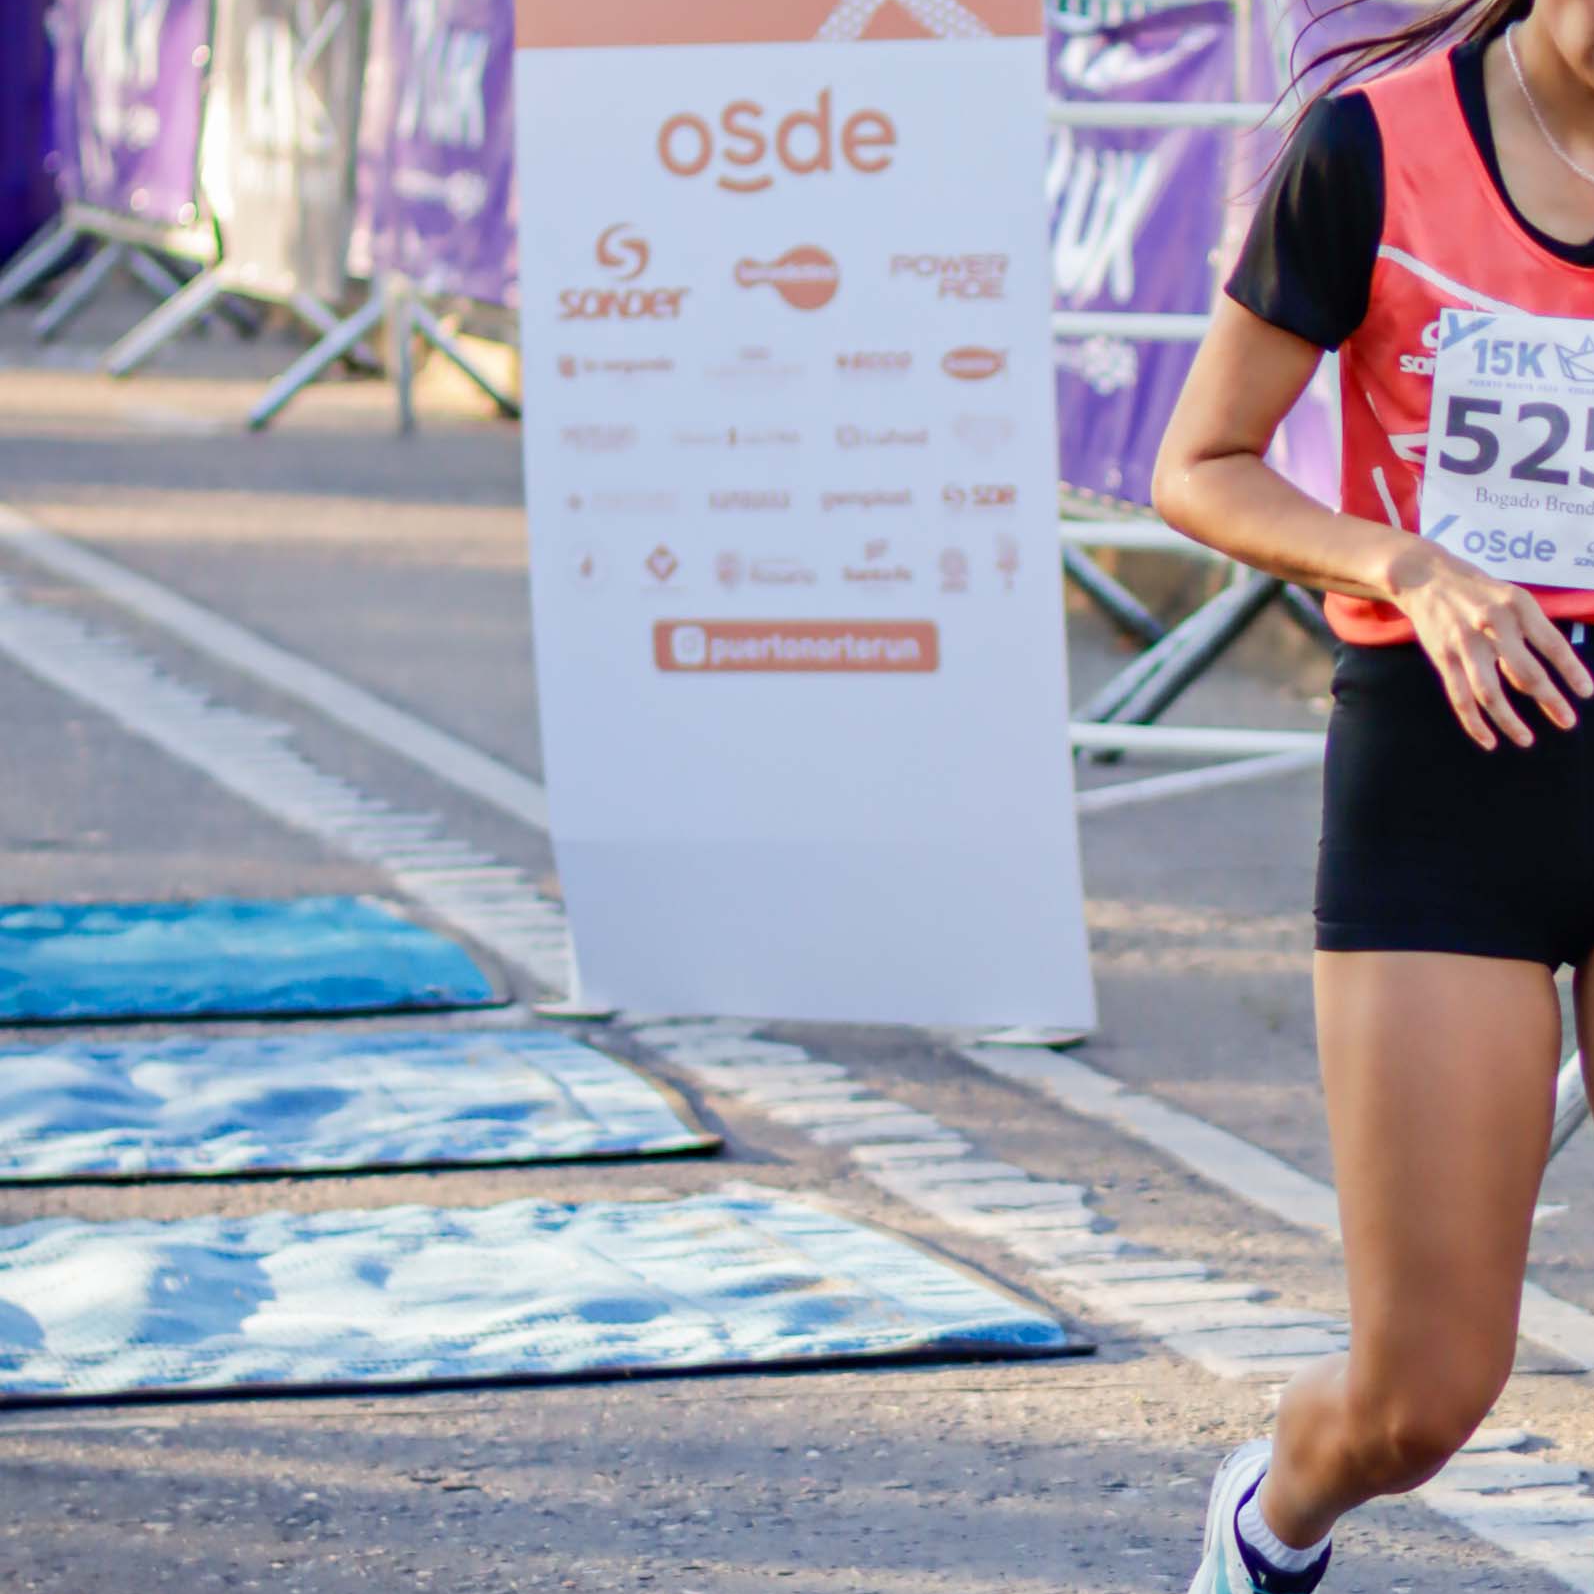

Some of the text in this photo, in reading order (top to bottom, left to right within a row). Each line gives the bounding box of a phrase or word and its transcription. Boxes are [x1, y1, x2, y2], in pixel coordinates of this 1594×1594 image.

[657, 87, 897, 193] osde
[1472, 338, 1547, 379] 15K
[1475, 486, 1540, 510] Bogado
[1463, 528, 1557, 564] osde
